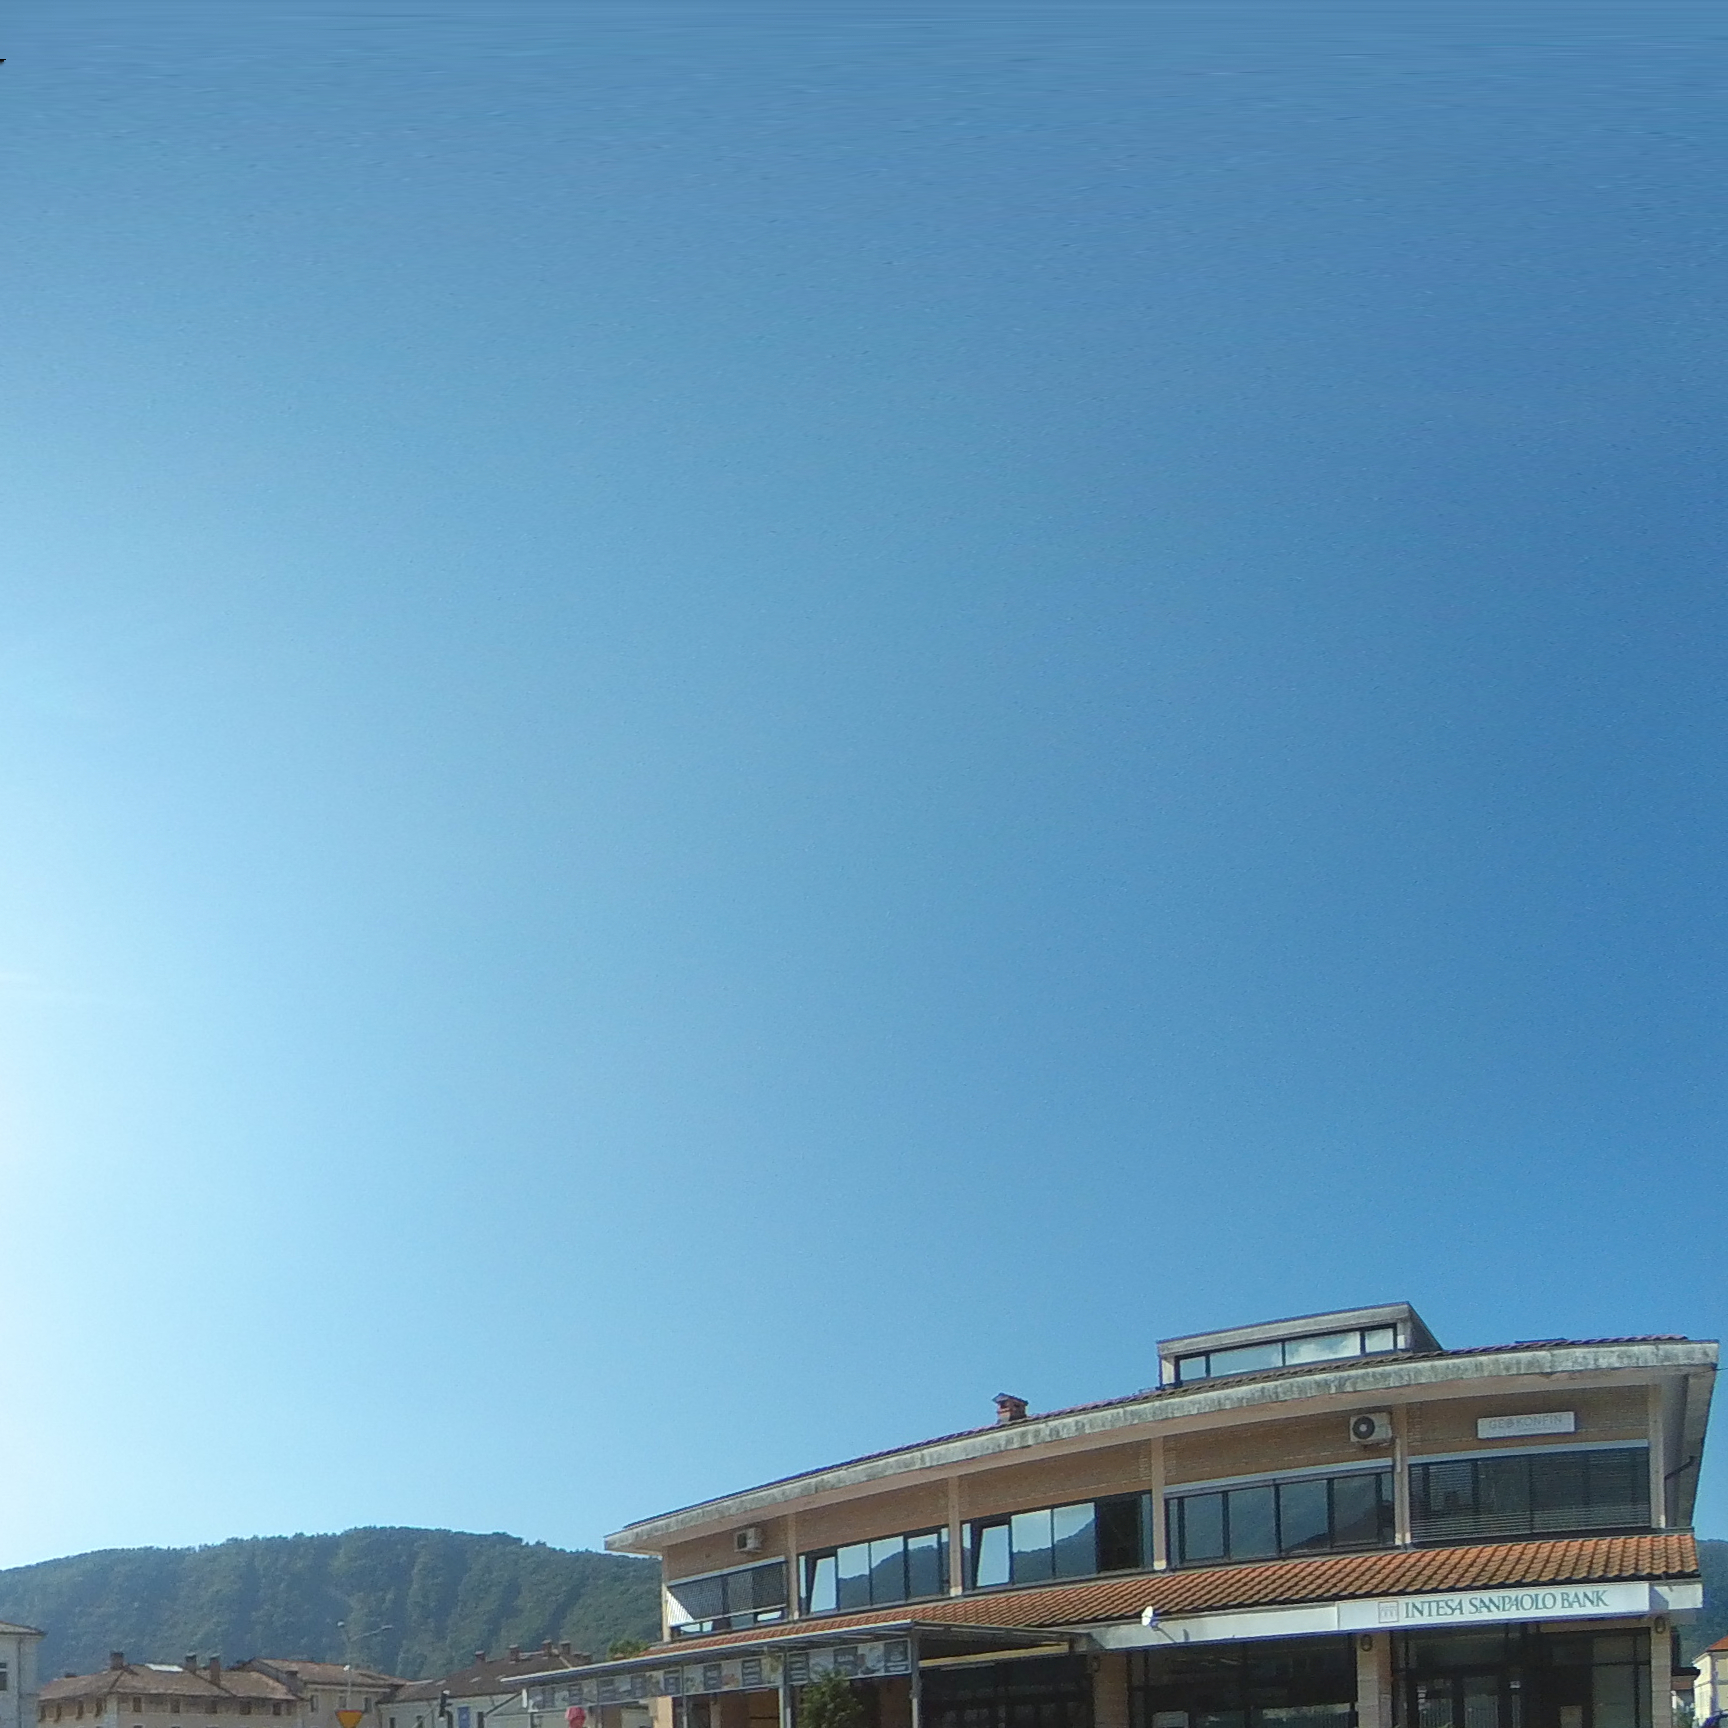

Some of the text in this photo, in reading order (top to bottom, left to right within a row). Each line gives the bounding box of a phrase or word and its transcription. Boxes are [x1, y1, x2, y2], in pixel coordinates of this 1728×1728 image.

[1405, 1589, 1609, 1619] INTESA SANPAOLO BANK
